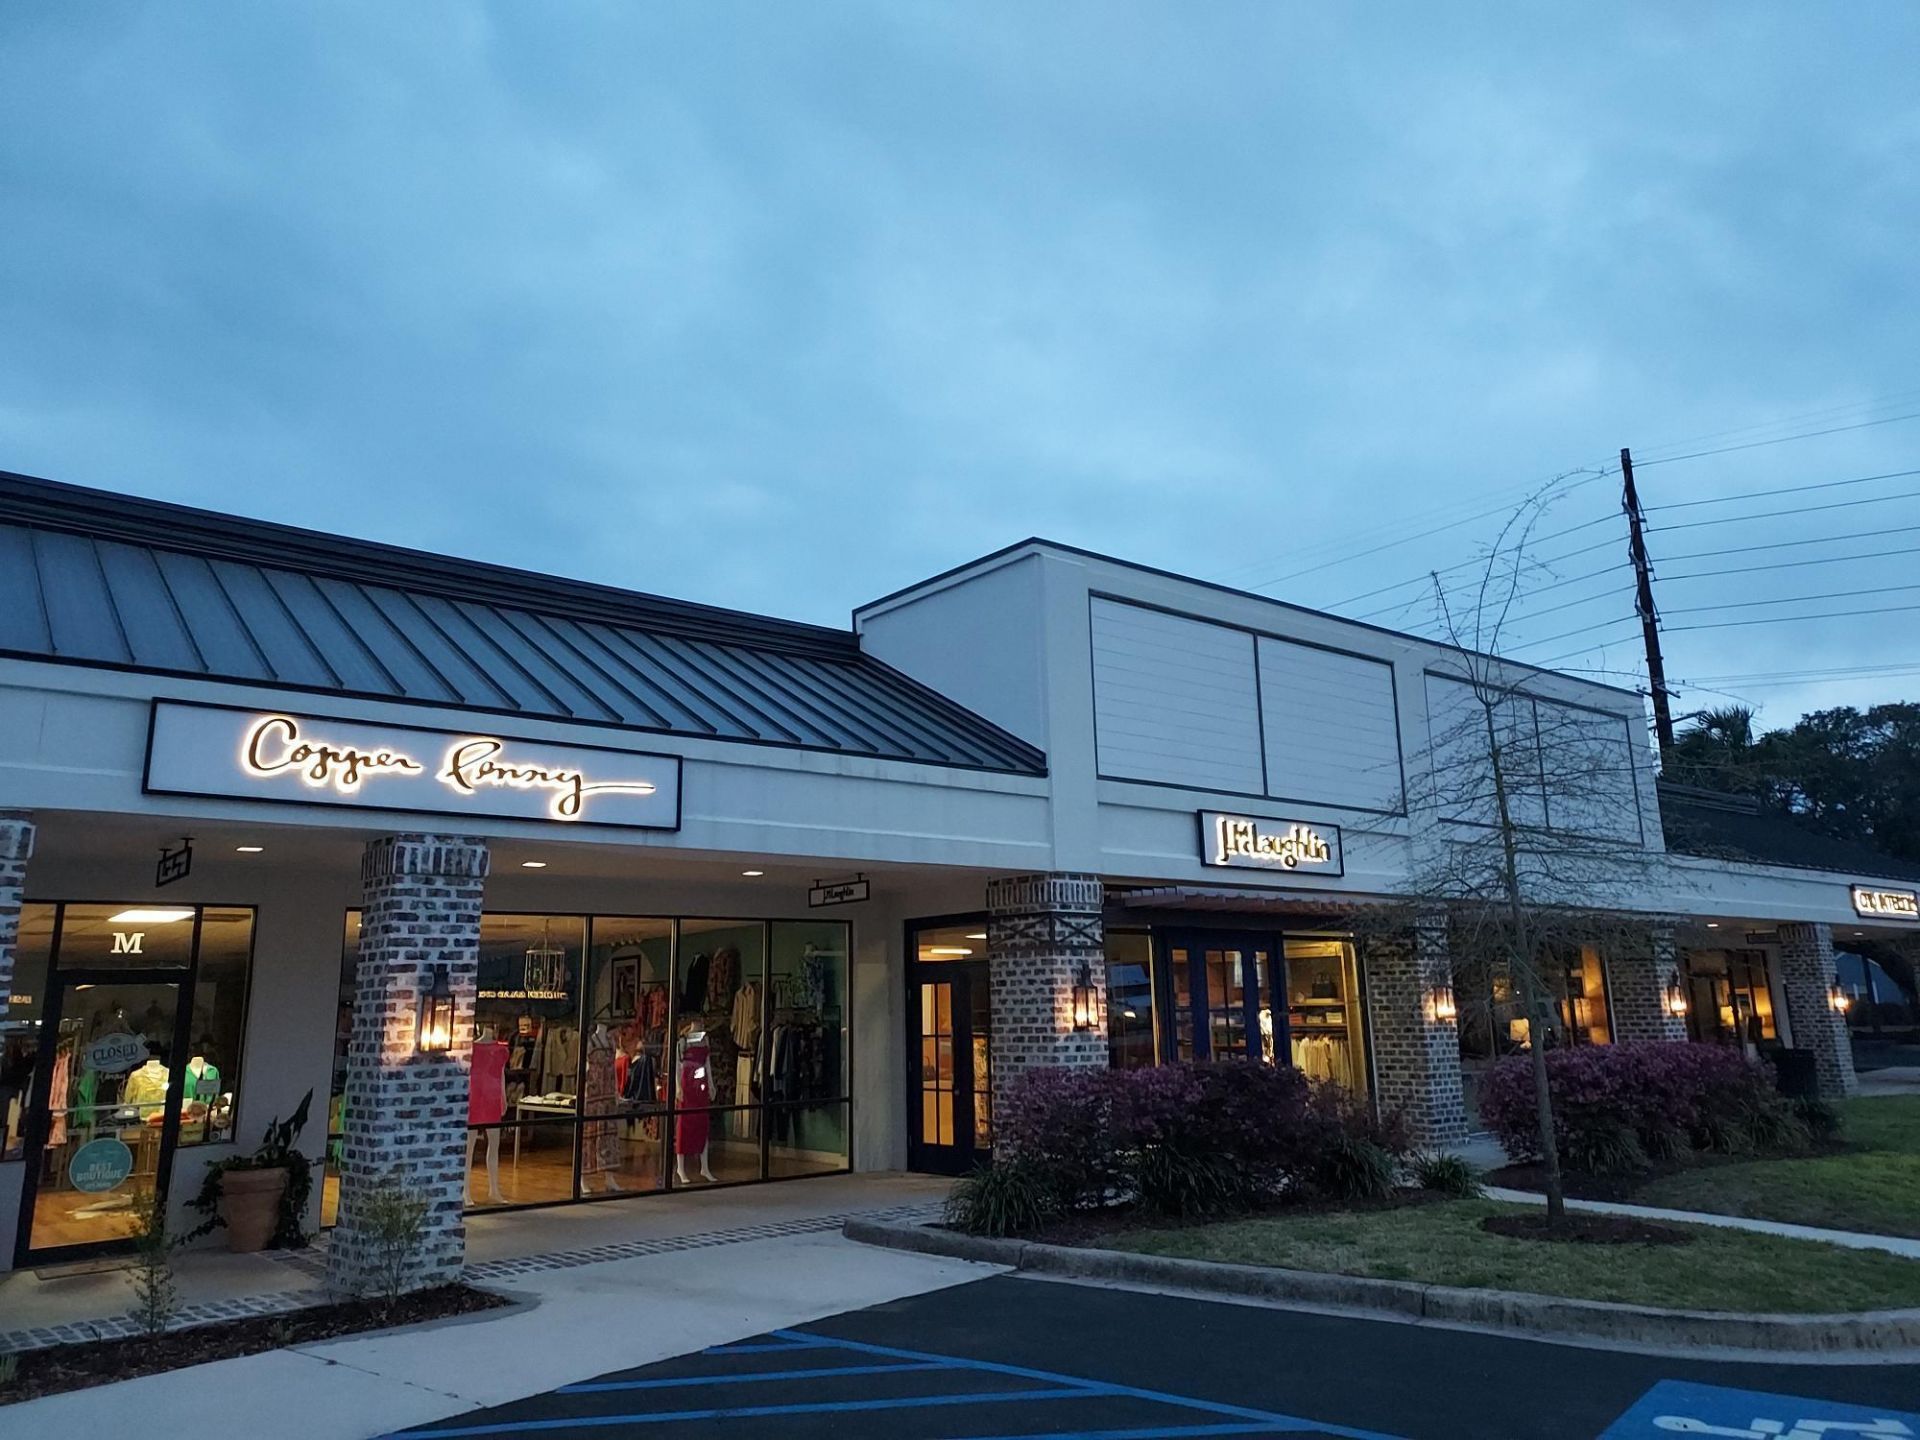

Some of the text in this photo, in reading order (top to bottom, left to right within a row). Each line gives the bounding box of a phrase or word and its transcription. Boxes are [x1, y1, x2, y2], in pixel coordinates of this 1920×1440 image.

[247, 718, 656, 816] Copper Penny
[93, 1042, 138, 1061] CLOSED
[76, 1168, 123, 1182] BOUTIQUE
[89, 1162, 112, 1172] BEST
